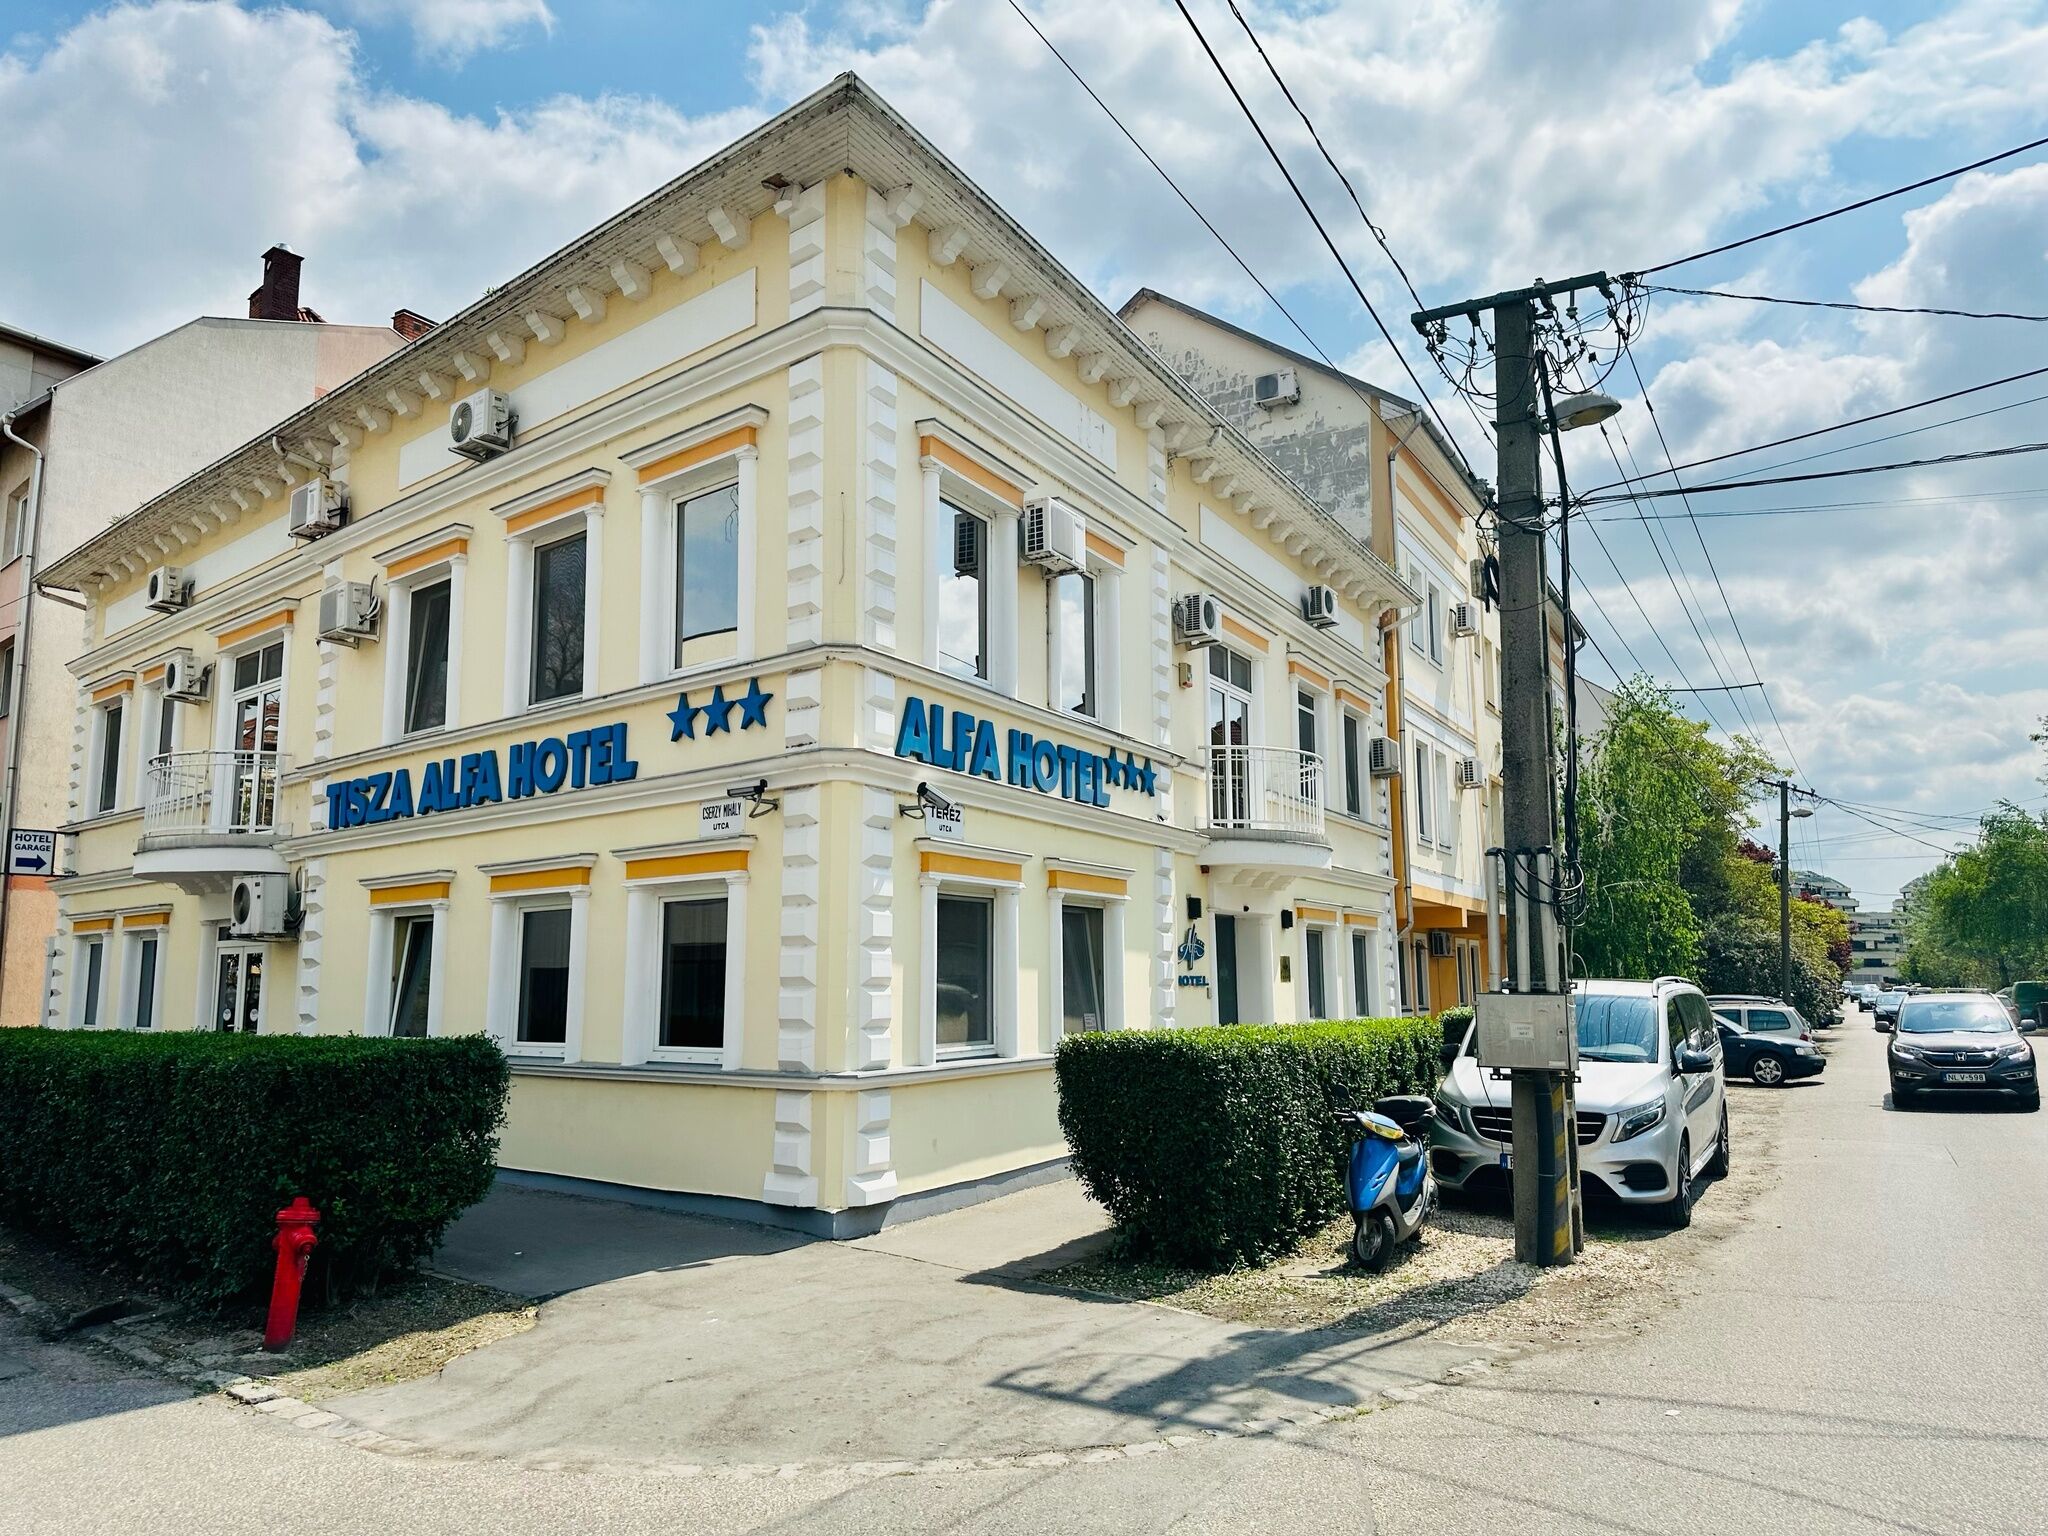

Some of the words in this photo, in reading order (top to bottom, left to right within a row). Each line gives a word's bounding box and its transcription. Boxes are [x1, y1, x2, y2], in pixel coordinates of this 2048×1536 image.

[895, 697, 1001, 780] ALFA
[1007, 728, 1111, 808] HOTEL
[327, 768, 414, 829] TISZA
[417, 750, 502, 815] ALFA
[508, 722, 638, 799] HOTEL
[702, 805, 721, 820] CSERZY
[723, 801, 741, 817] MIHÁLY
[930, 805, 961, 822] TERÉZ
[713, 822, 729, 830] UTCA
[15, 833, 51, 843] HOTEL
[14, 843, 51, 851] GARAGE
